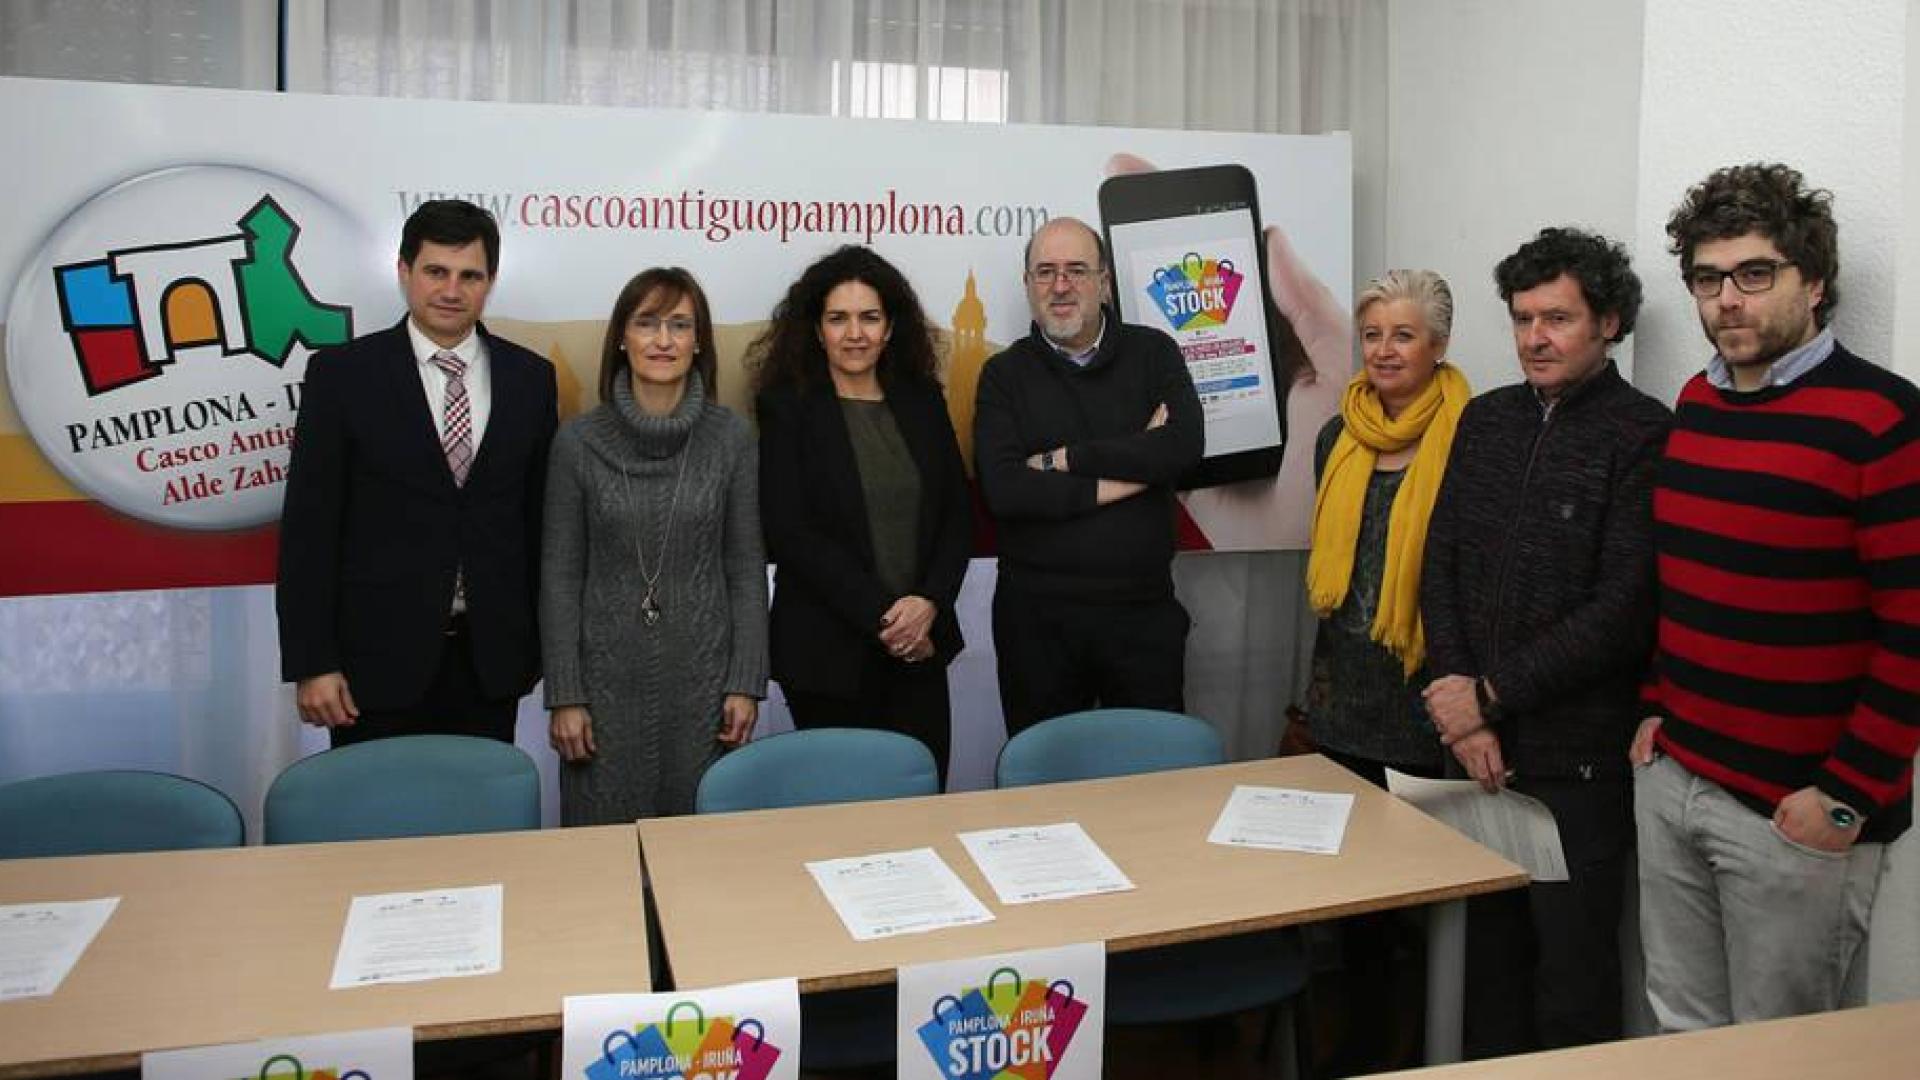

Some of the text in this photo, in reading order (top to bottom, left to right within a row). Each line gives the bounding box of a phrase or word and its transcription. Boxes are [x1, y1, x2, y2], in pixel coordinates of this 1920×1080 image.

[1165, 287, 1227, 317] STOCK
[66, 391, 258, 453] PAMPLONA
[136, 441, 220, 473] Casco
[162, 473, 224, 506] Alde
[949, 1012, 1012, 1036] PAMPLONA
[620, 1053, 692, 1077] PAMPLONA
[948, 1024, 1054, 1077] STOCK
